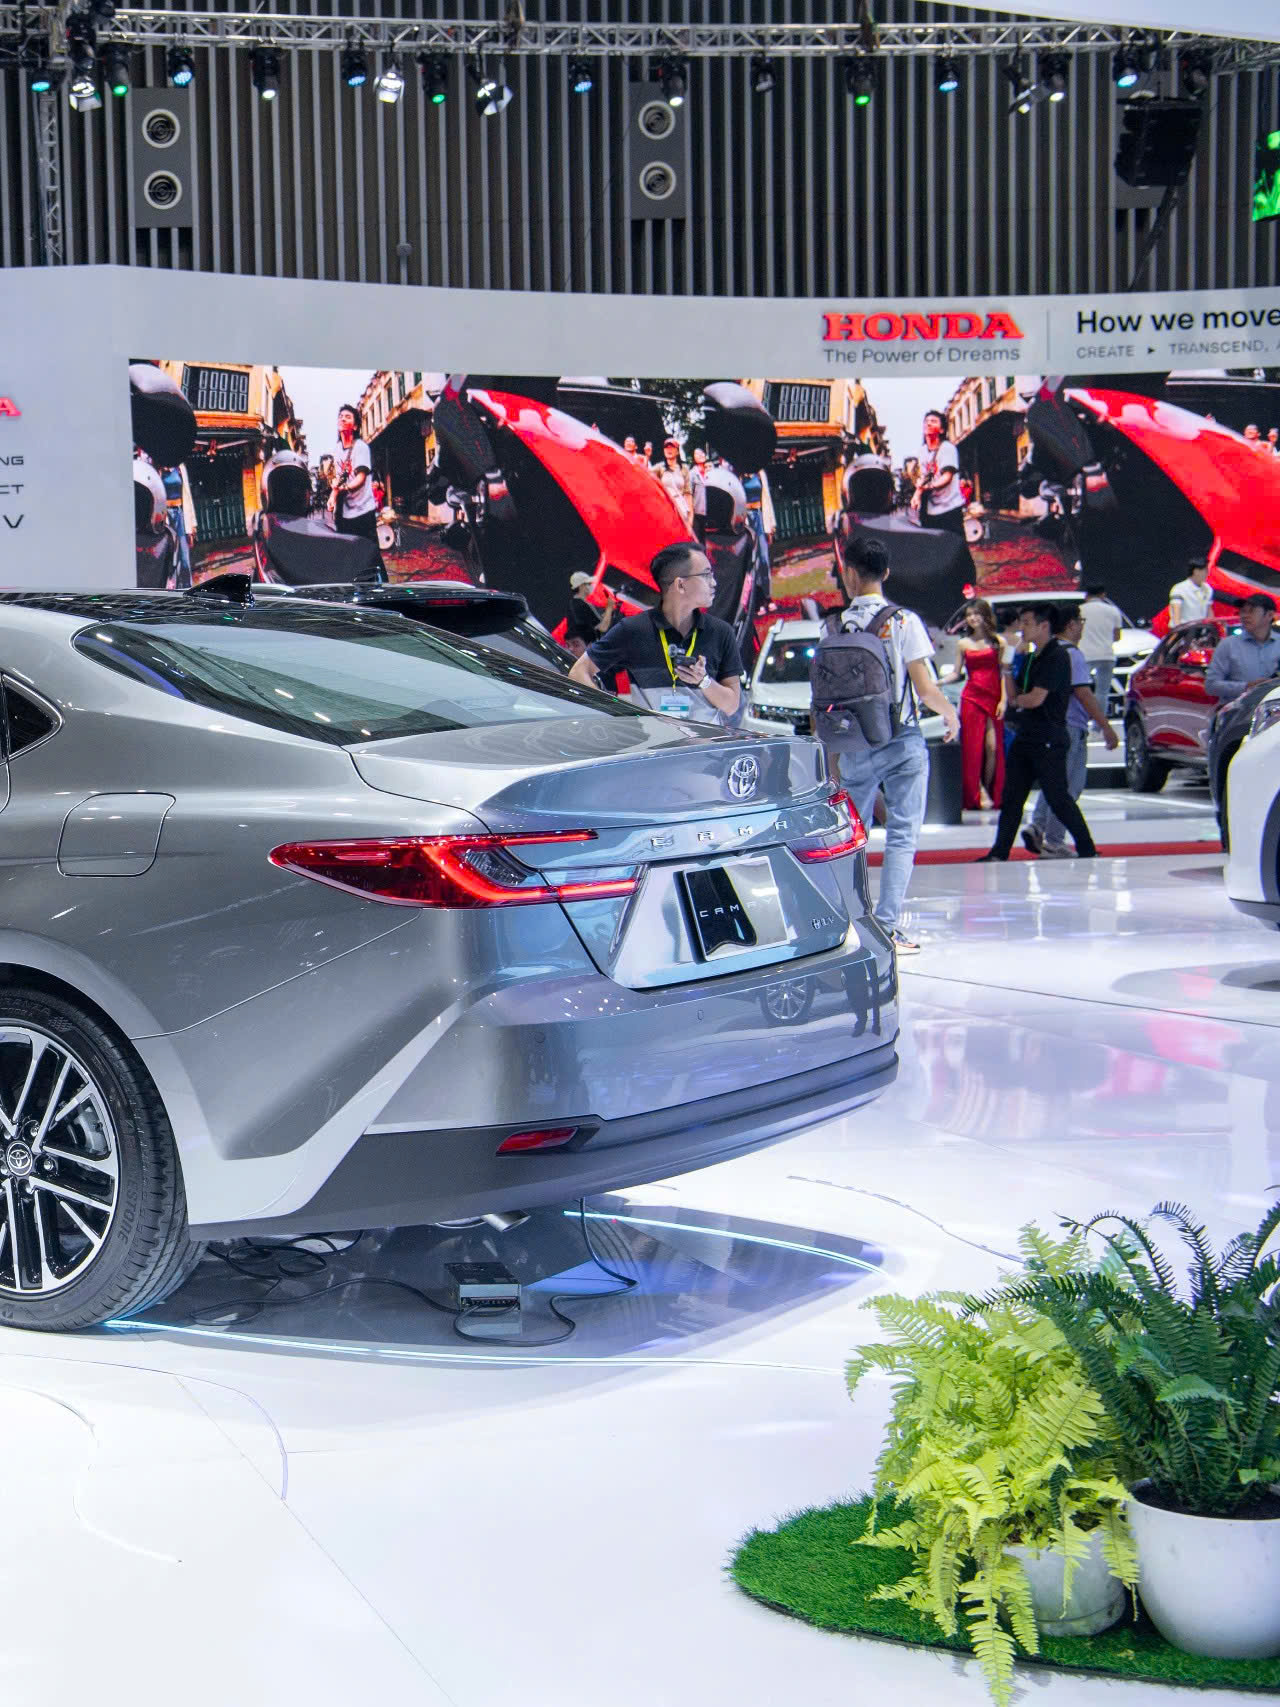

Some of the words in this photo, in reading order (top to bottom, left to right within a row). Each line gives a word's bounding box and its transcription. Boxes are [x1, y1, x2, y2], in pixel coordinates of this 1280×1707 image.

[822, 311, 1026, 341] HONDA
[1077, 310, 1142, 333] How
[1150, 312, 1194, 331] we
[1203, 309, 1280, 329] move
[824, 348, 857, 363] The
[862, 348, 918, 363] Power
[923, 347, 944, 362] of
[948, 347, 1020, 362] Dreams
[1076, 345, 1136, 359] CREATE
